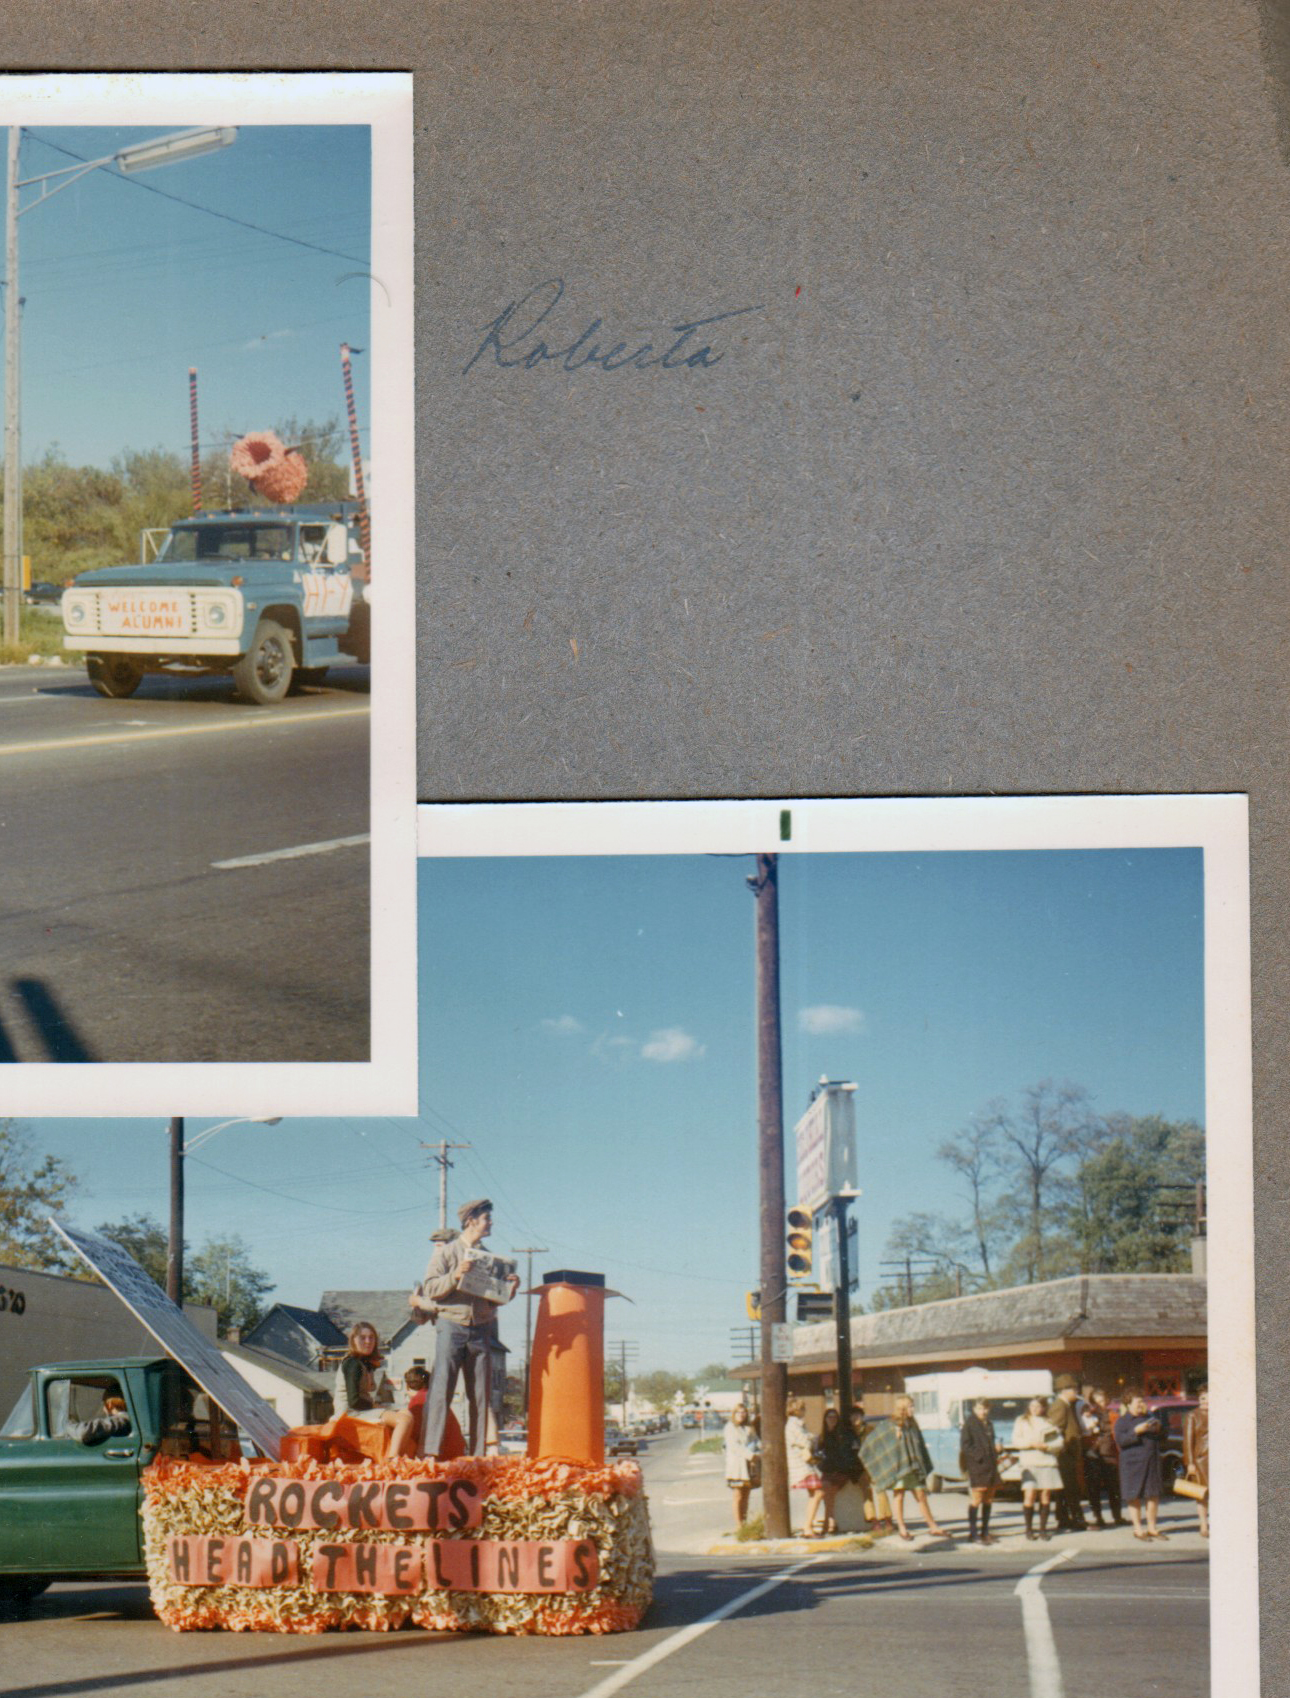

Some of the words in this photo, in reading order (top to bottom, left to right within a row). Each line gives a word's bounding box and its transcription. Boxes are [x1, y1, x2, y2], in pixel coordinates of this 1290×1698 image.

[462, 278, 766, 376] Roberta
[108, 601, 180, 613] WELCOME
[303, 575, 350, 611] HI-Y
[122, 615, 183, 629] ALUMNI
[248, 1478, 478, 1530] ROCKETS
[172, 1540, 289, 1584] HEAD
[318, 1543, 413, 1590] THE
[432, 1540, 591, 1589] LINES
